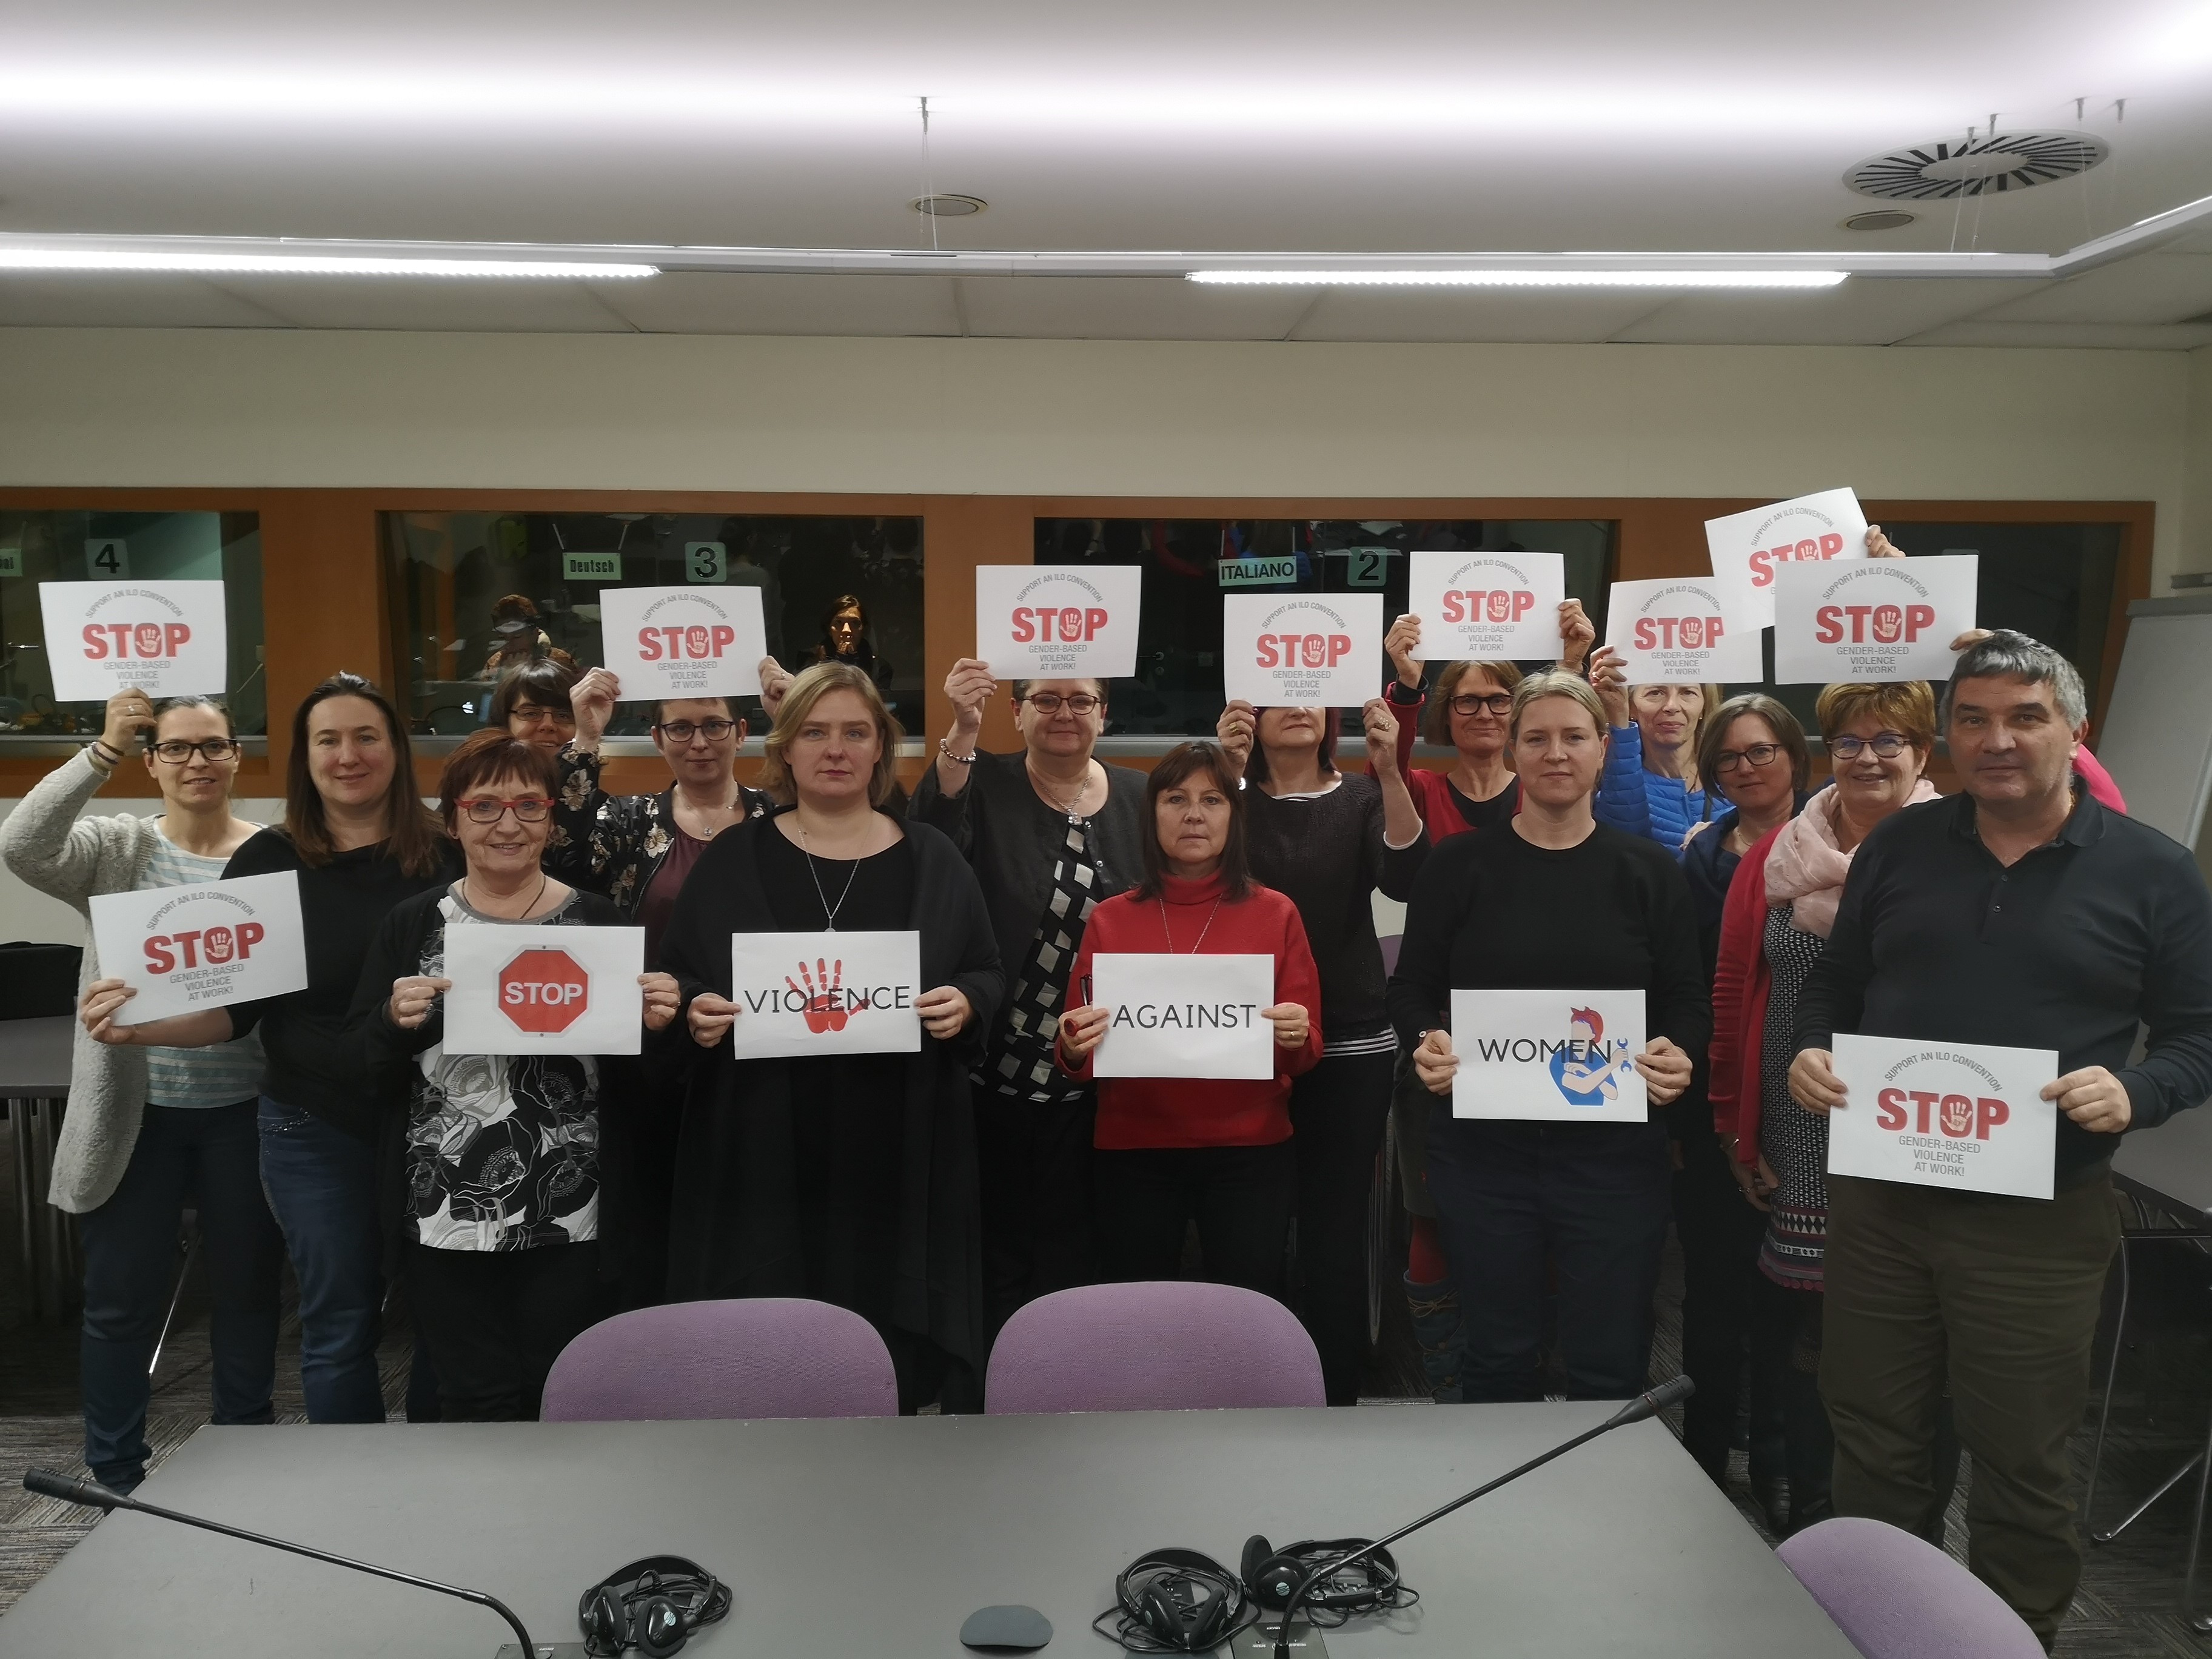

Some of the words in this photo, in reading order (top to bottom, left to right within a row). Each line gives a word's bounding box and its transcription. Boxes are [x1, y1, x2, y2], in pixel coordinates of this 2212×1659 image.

[1751, 518, 1774, 546] SUPPORT
[1774, 512, 1783, 521] AN
[1784, 508, 1794, 517] ILO
[1795, 508, 1834, 527] CONVENTION
[95, 544, 119, 574] 4
[570, 559, 614, 573] Deutsch
[694, 547, 718, 578] 3
[1221, 562, 1295, 580] ITALIANO
[1357, 551, 1379, 580] 2
[1448, 563, 1472, 585] SUPPORT
[1495, 560, 1530, 585] CONVENTION
[1017, 578, 1042, 602] SUPPORT
[1067, 575, 1104, 602] CONVENTION
[1823, 573, 1852, 600] SUPPORT
[1855, 569, 1866, 578] AN
[1884, 568, 1929, 598] CONVENTION
[85, 594, 112, 618] SUPPORT
[642, 598, 666, 622] SUPPORT
[690, 595, 728, 619] CONVENTION
[1443, 590, 1535, 623] STOP
[1641, 591, 1664, 612] SUPPORT
[1012, 608, 1108, 642] STOP
[1261, 606, 1287, 629] SUPPORT
[1310, 602, 1346, 628] CONVENTION
[1816, 605, 1935, 643] STOP
[83, 623, 190, 660] STOP
[639, 626, 734, 661] STOP
[1634, 617, 1724, 650] STOP
[1256, 634, 1351, 668] STOP
[1837, 646, 1909, 655] GENDER-BASED
[657, 662, 717, 670] GENDER-BASED
[146, 900, 176, 930] SUPPORT
[178, 894, 190, 905] AN
[191, 892, 204, 901] ILO
[207, 892, 255, 916] CONVENTION
[144, 922, 264, 974] STOP
[170, 964, 244, 984] GENDER-BASED
[185, 976, 232, 991] VIOLENCE
[188, 992, 201, 1002] AT
[202, 987, 233, 999] WORK!
[504, 982, 583, 1005] STOP
[744, 985, 910, 1014] VIOLENCE
[1112, 1004, 1256, 1028] AGAINST
[1478, 1039, 1611, 1064] WOMEN
[1885, 1055, 1919, 1081] SUPPORT
[1921, 1052, 1933, 1061] AN
[1936, 1052, 1950, 1061] ILO
[1953, 1054, 2003, 1091] CONVENTION
[1877, 1088, 2009, 1141] STOP
[1899, 1135, 1980, 1153] GENDER-BASED
[1914, 1149, 1964, 1164] VIOLENCE
[1914, 1162, 1927, 1171] AT
[1930, 1164, 1965, 1176] WORK!
